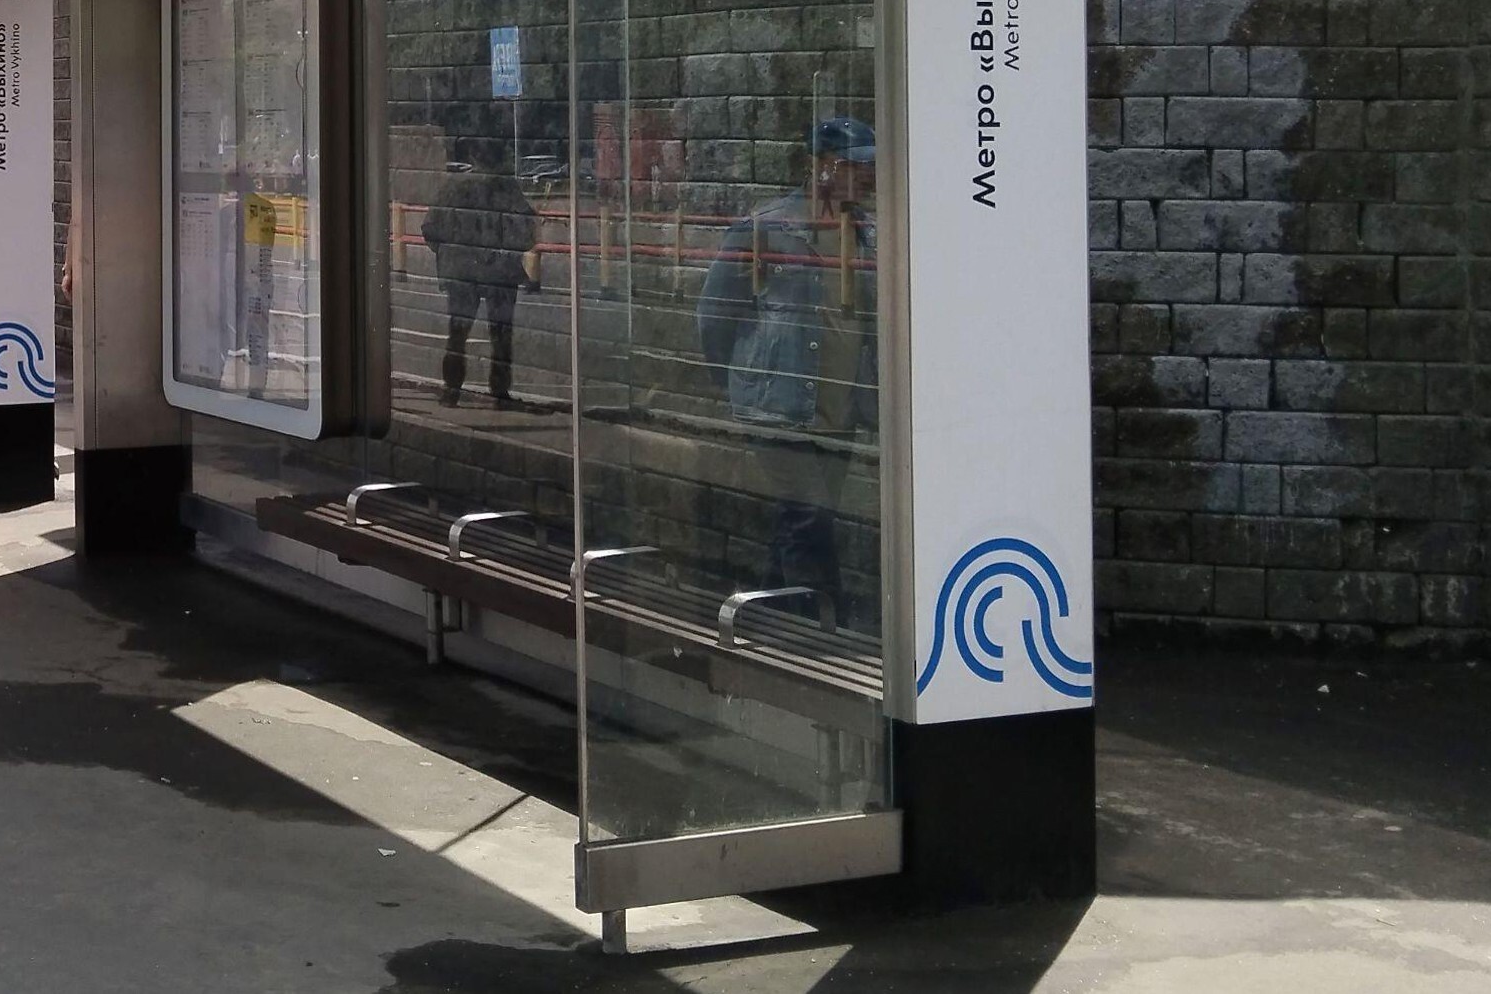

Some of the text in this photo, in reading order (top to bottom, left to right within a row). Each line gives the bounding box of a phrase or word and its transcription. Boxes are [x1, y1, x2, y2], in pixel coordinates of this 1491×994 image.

[10, 23, 22, 107] Metro Vykhino
[972, 84, 1001, 209] Метро
